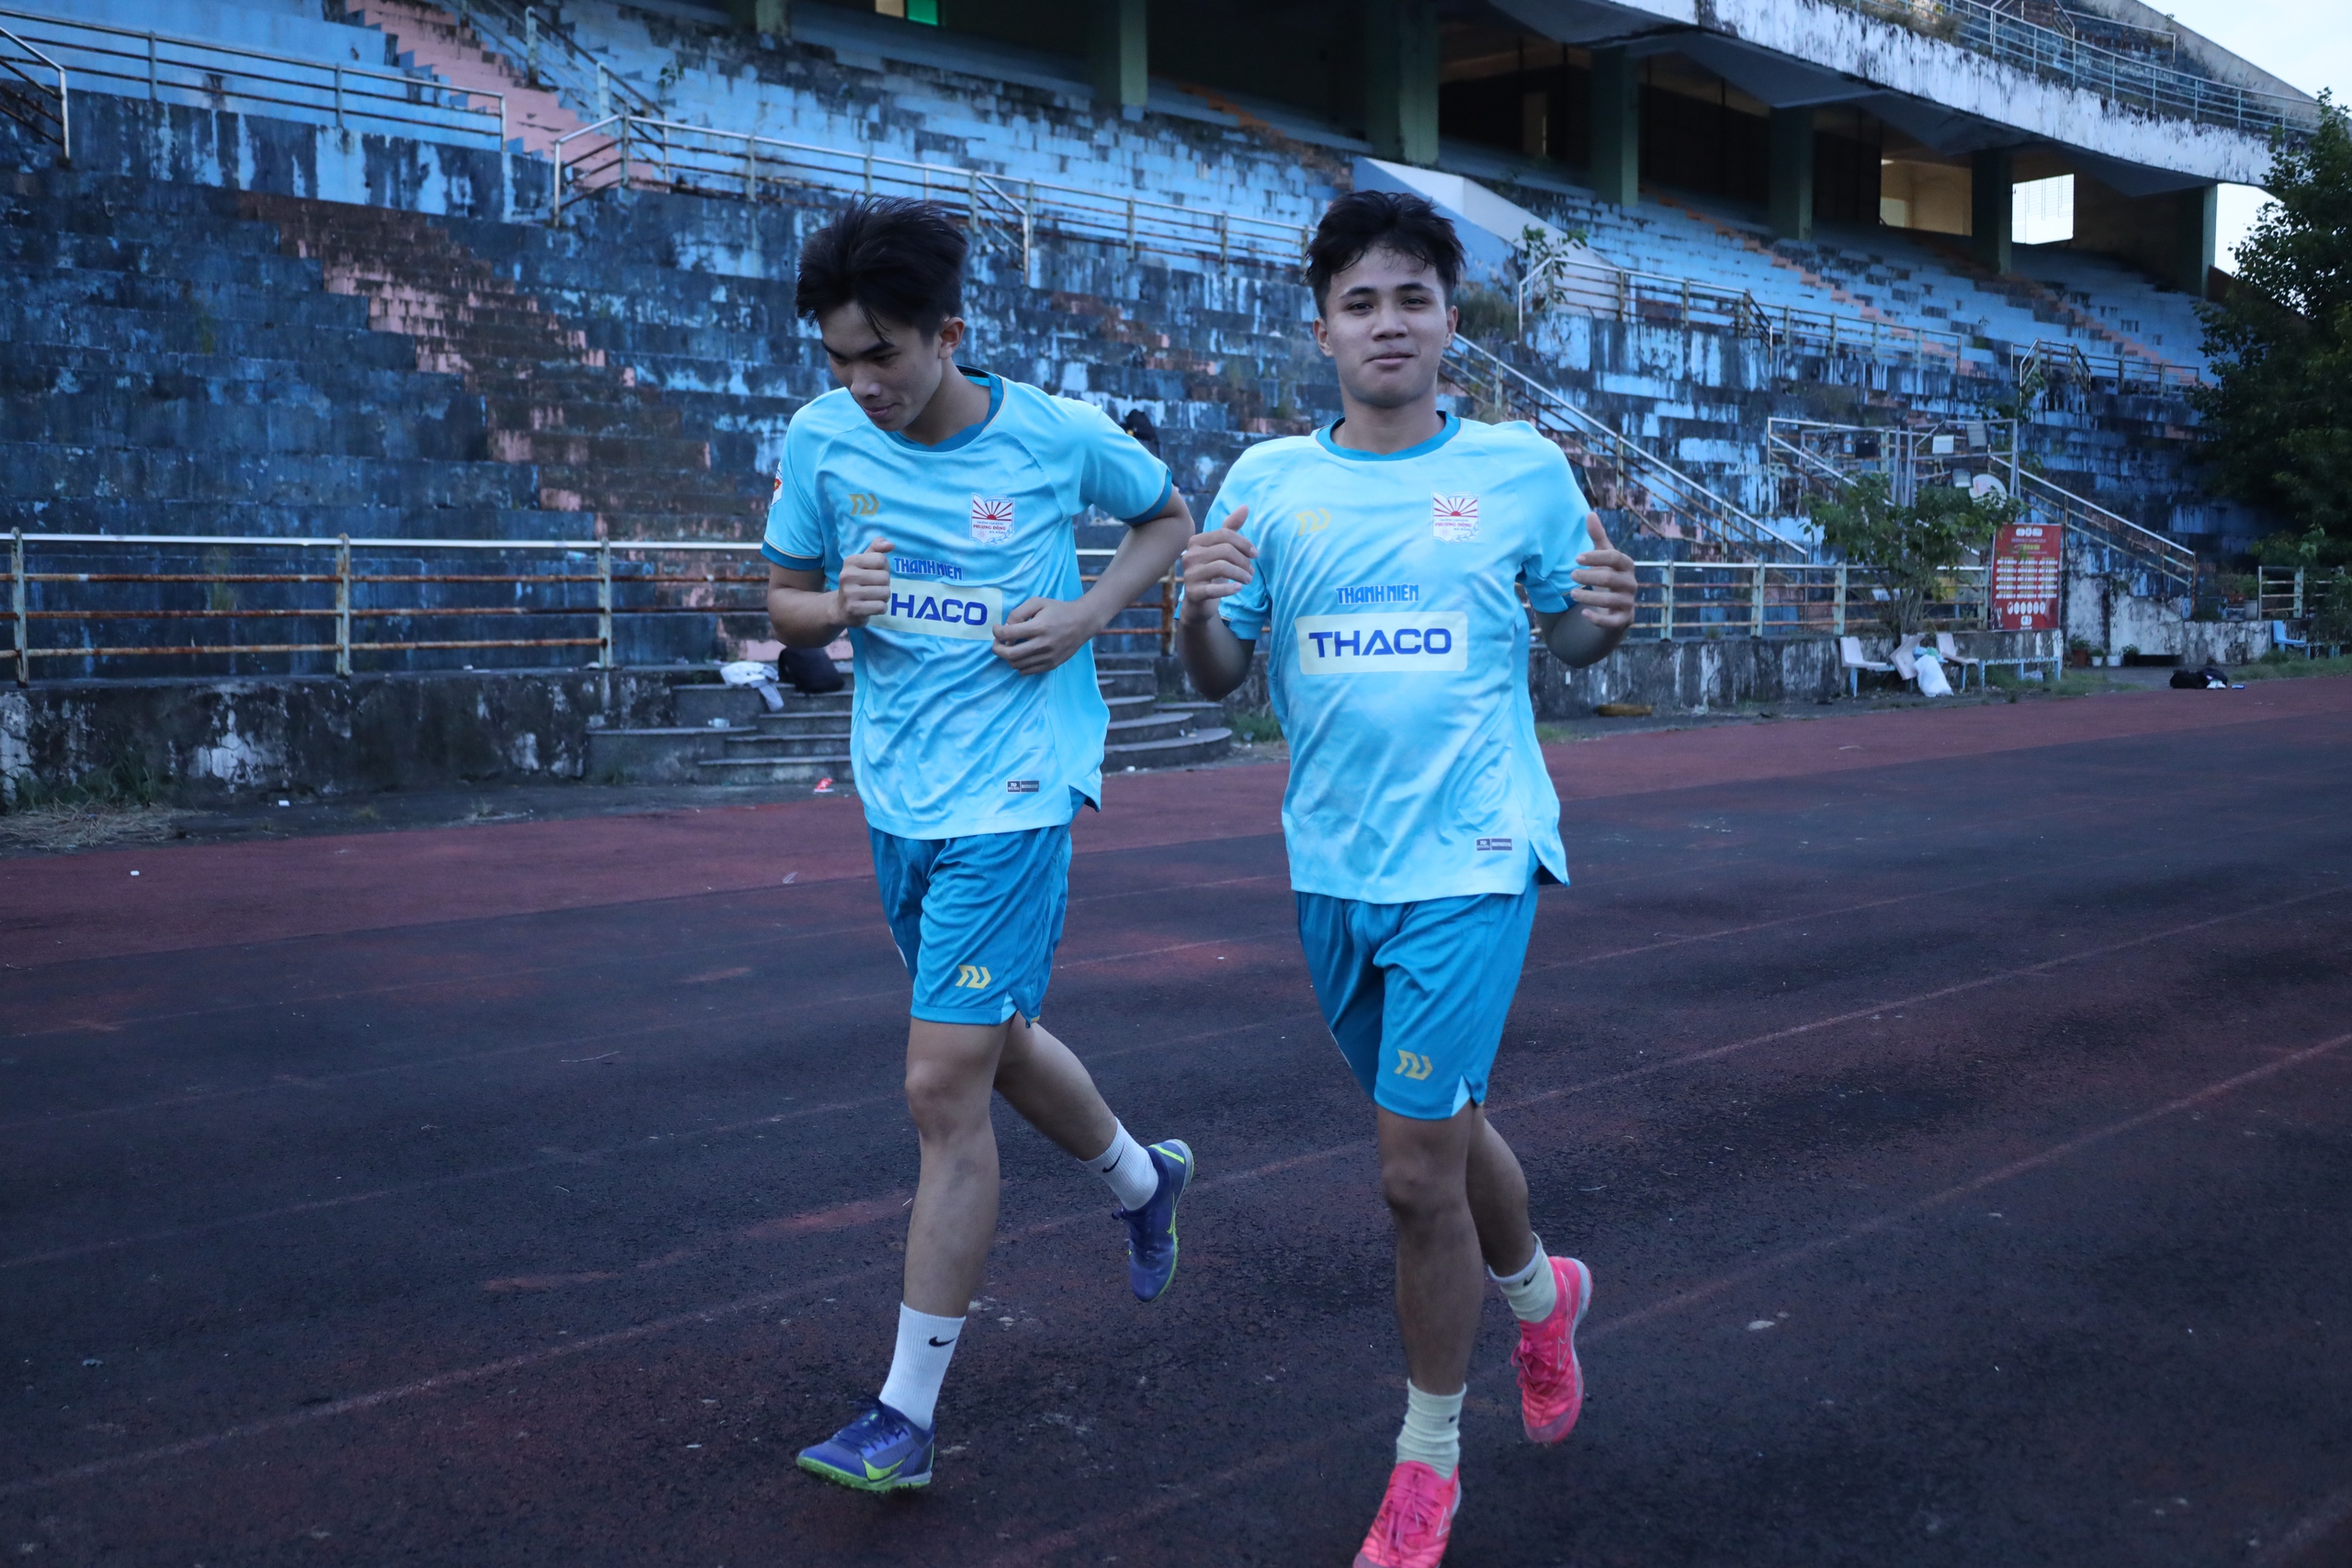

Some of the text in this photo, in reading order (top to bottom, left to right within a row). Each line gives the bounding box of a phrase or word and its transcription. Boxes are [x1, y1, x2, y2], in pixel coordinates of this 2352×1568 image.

[894, 558, 936, 574] THANH
[1336, 583, 1419, 604] THANH NIÊN
[890, 592, 988, 626] HACO
[1308, 628, 1452, 658] THACO
